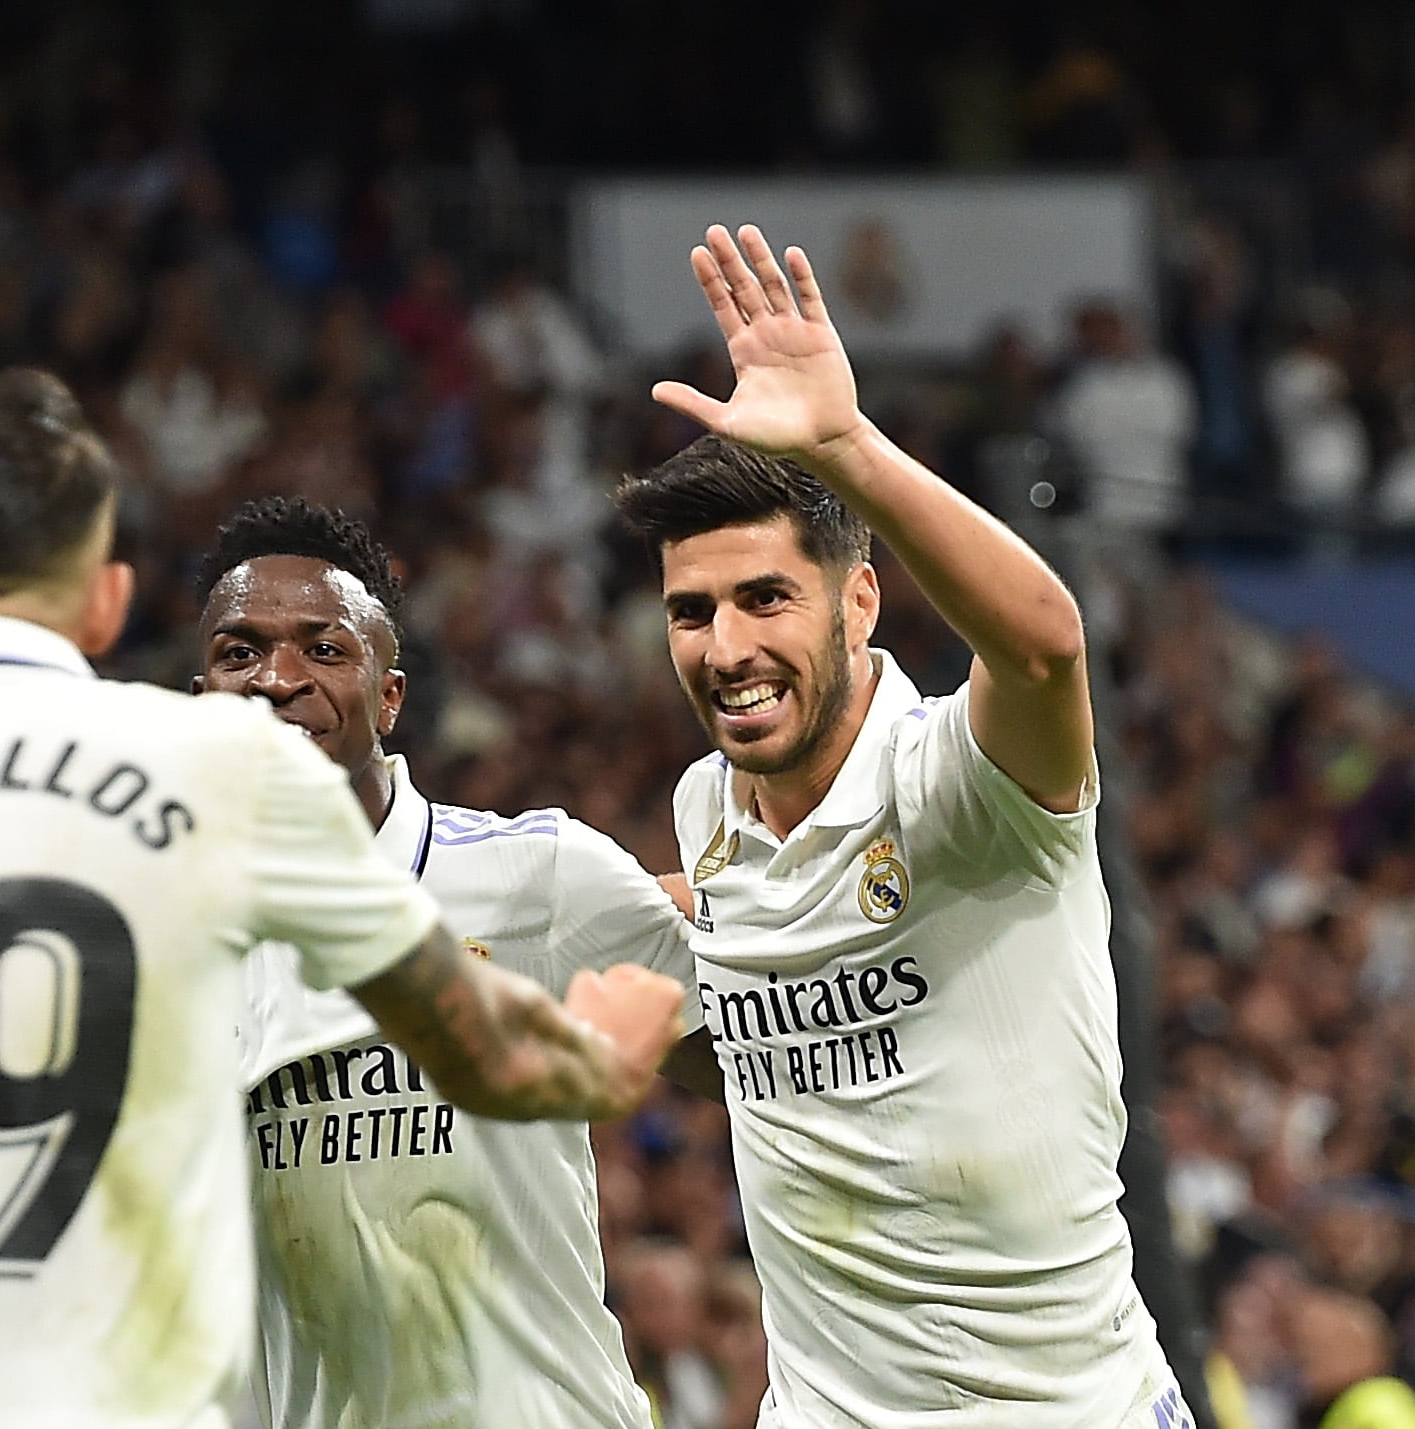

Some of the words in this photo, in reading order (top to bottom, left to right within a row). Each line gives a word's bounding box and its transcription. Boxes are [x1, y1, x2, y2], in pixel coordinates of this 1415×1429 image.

[698, 956, 928, 1041] Emirates
[733, 1050, 777, 1101] FLY
[786, 1027, 905, 1094] BETTER
[257, 1117, 308, 1169] FLY
[321, 1103, 454, 1164] BETTER
